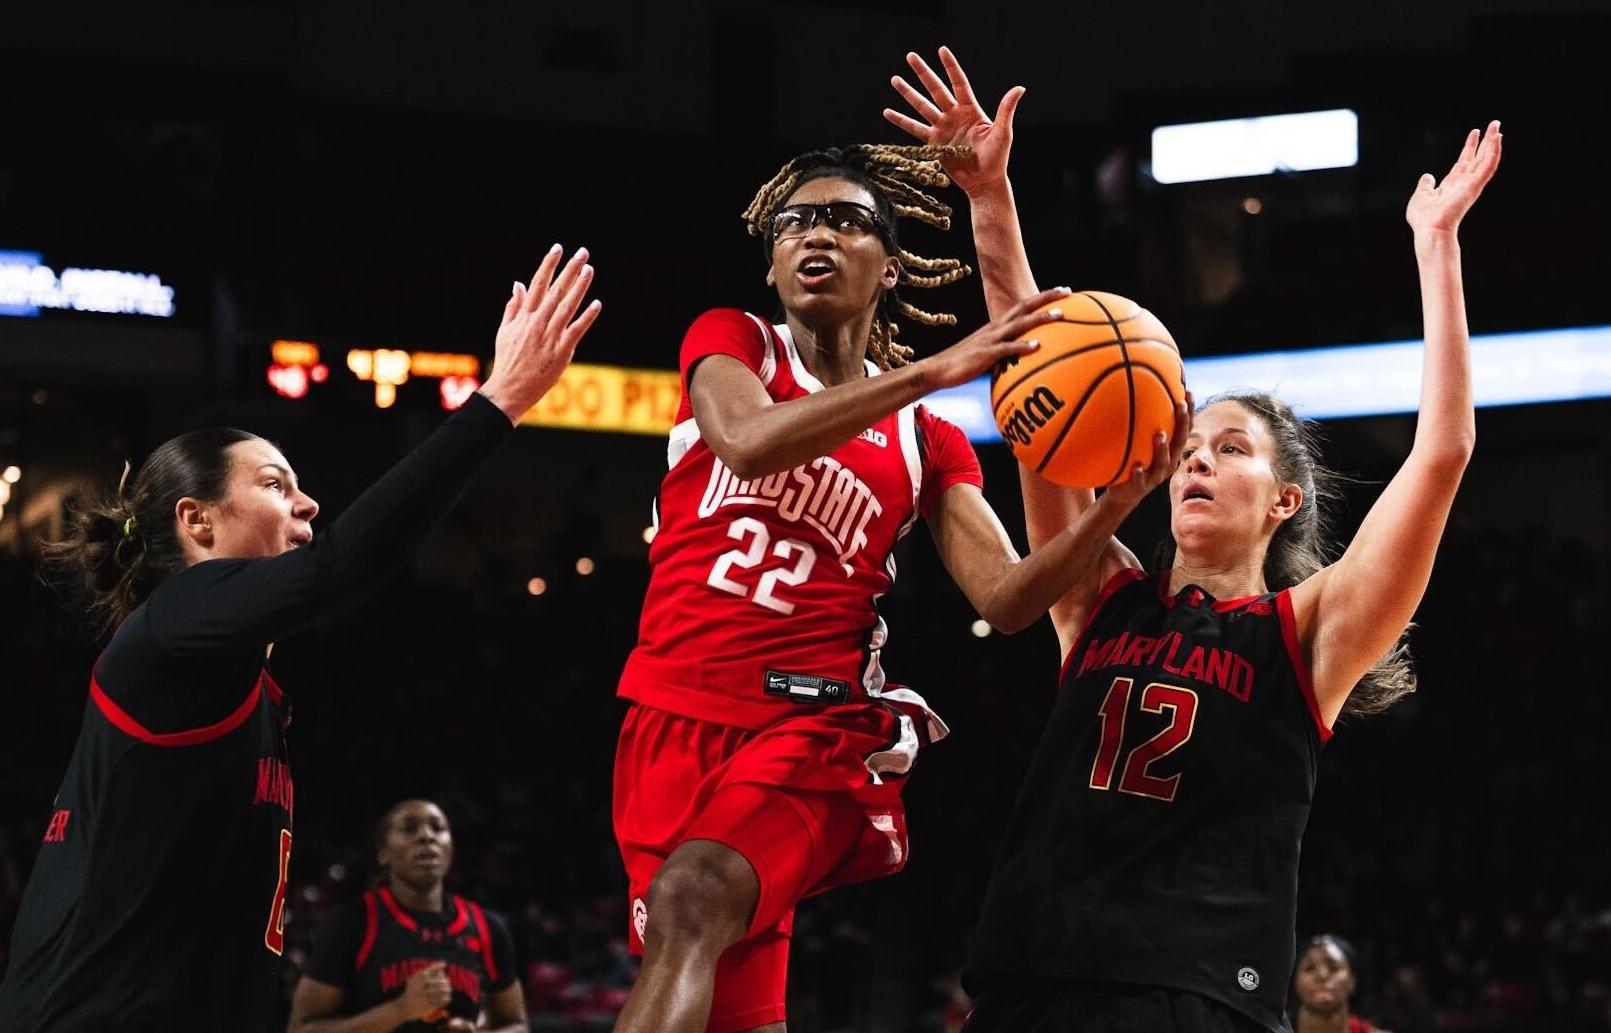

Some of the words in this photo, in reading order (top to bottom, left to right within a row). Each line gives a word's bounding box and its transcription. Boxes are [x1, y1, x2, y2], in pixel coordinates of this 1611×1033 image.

[532, 377, 603, 419] DO
[1002, 386, 1065, 450] Wils
[698, 455, 790, 519] OO
[777, 455, 883, 578] STATE
[707, 516, 817, 615] 22
[1076, 631, 1255, 704] MARYLAND
[1089, 676, 1199, 802] 12
